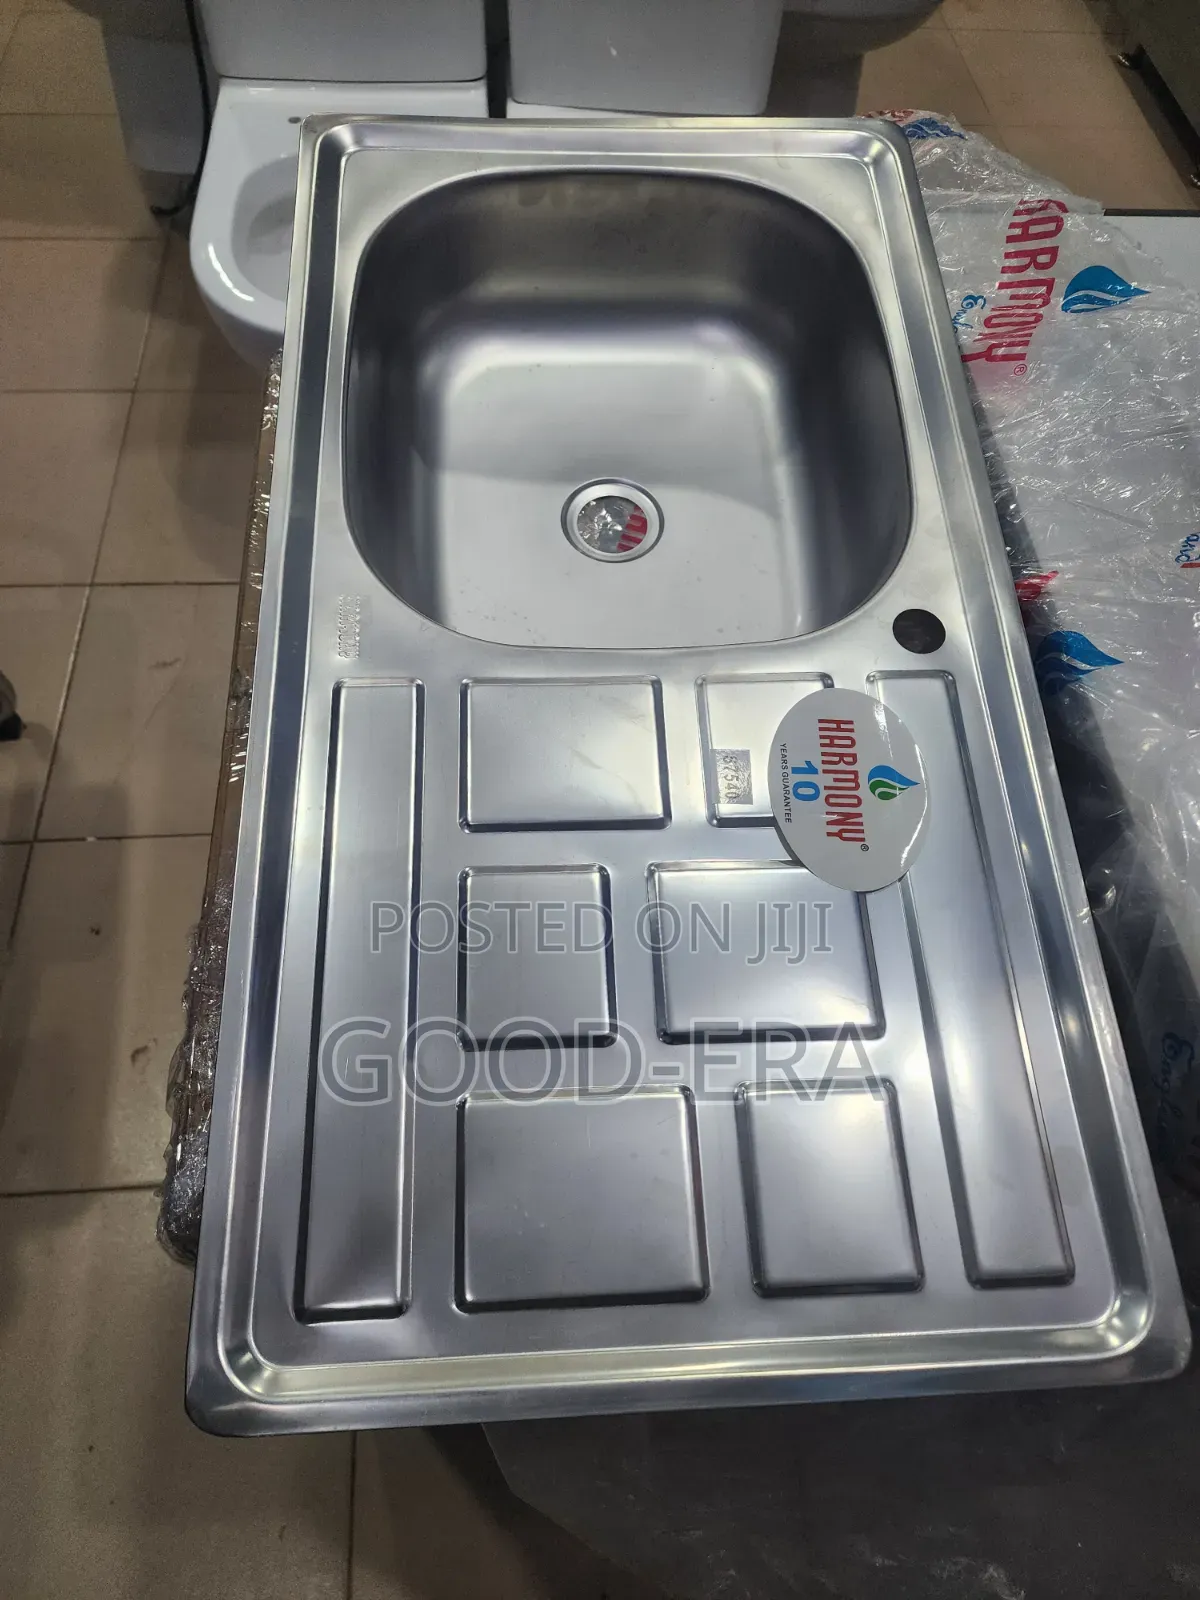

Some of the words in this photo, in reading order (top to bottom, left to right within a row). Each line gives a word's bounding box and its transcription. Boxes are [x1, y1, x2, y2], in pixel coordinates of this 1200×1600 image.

[780, 743, 788, 770] YEARS
[782, 771, 792, 823] GUARANTEE
[791, 760, 820, 802] 10
[818, 718, 866, 843] HARMONY
